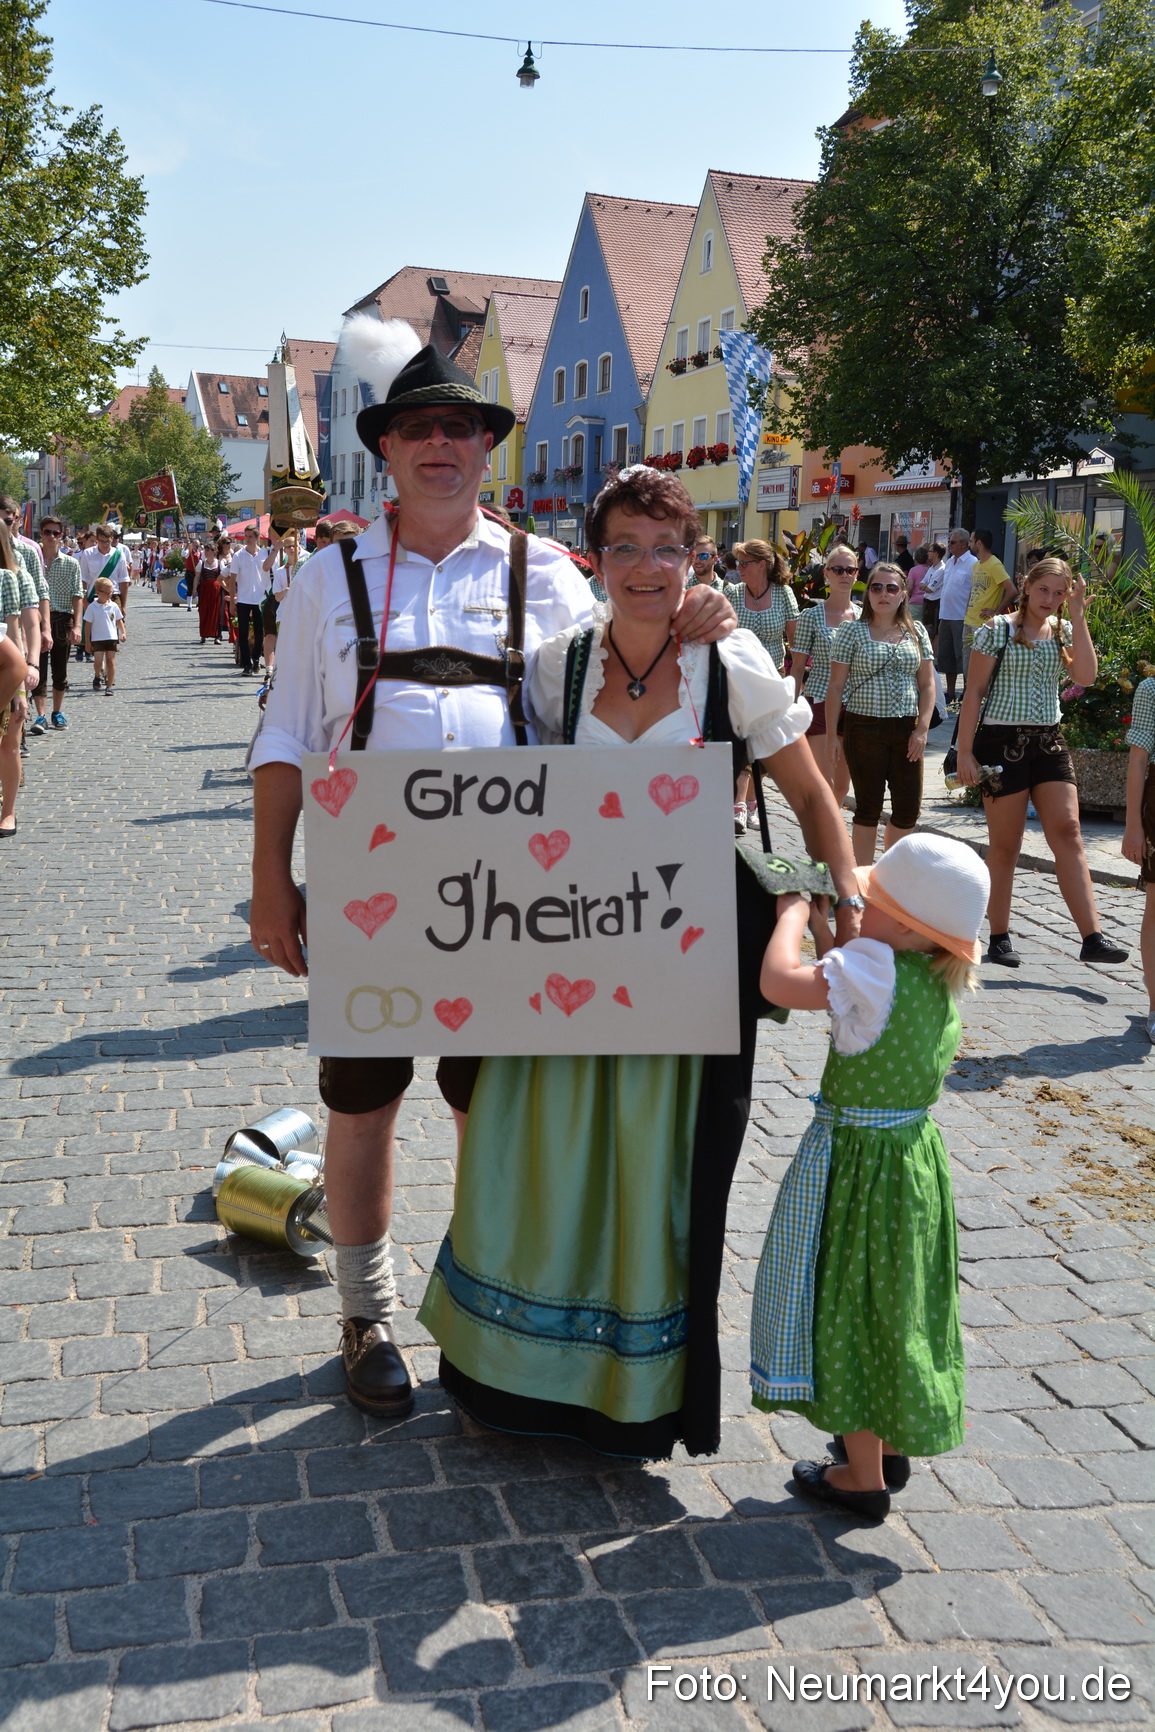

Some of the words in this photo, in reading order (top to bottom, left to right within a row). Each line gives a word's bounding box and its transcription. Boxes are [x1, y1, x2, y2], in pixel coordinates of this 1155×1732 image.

[767, 435, 780, 443] KINO
[404, 763, 548, 821] Grod
[425, 859, 684, 952] g'heirat!
